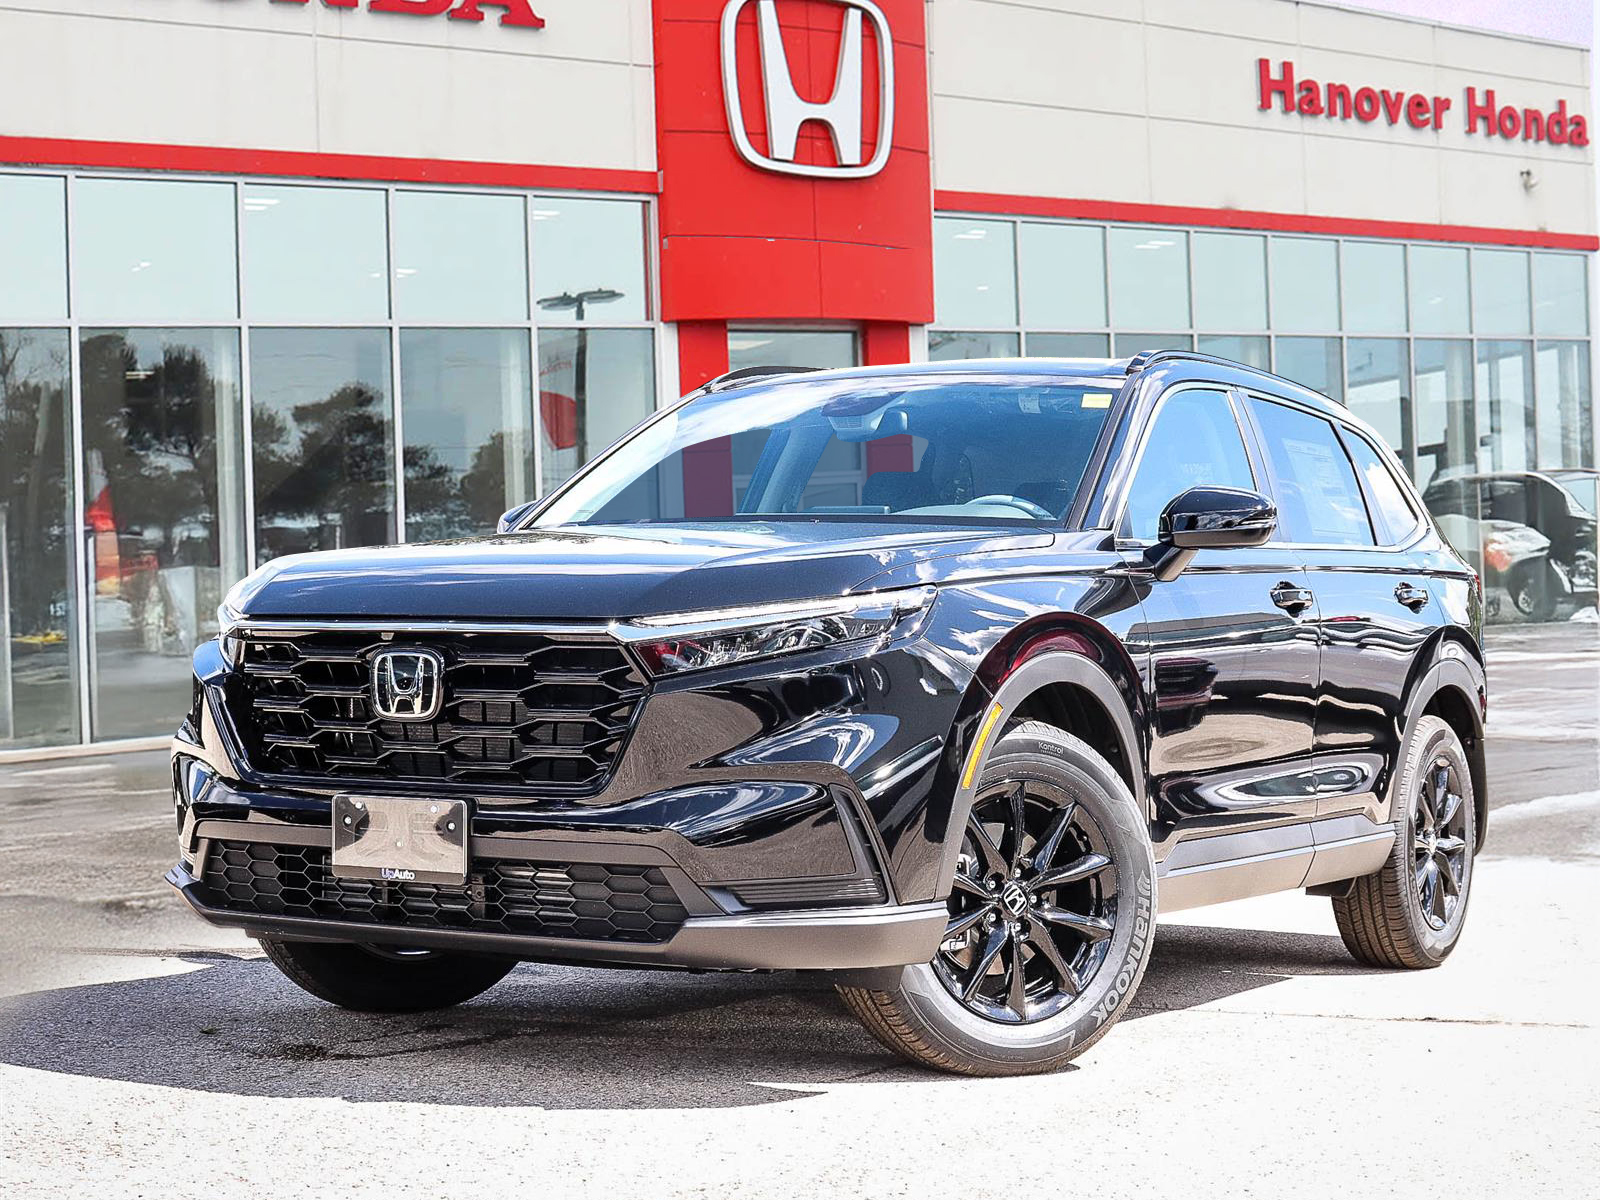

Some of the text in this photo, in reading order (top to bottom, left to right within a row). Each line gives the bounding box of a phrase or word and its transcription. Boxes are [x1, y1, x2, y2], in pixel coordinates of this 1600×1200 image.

[1257, 58, 1589, 146] Hanover Honda
[381, 868, 416, 880] UpAuto
